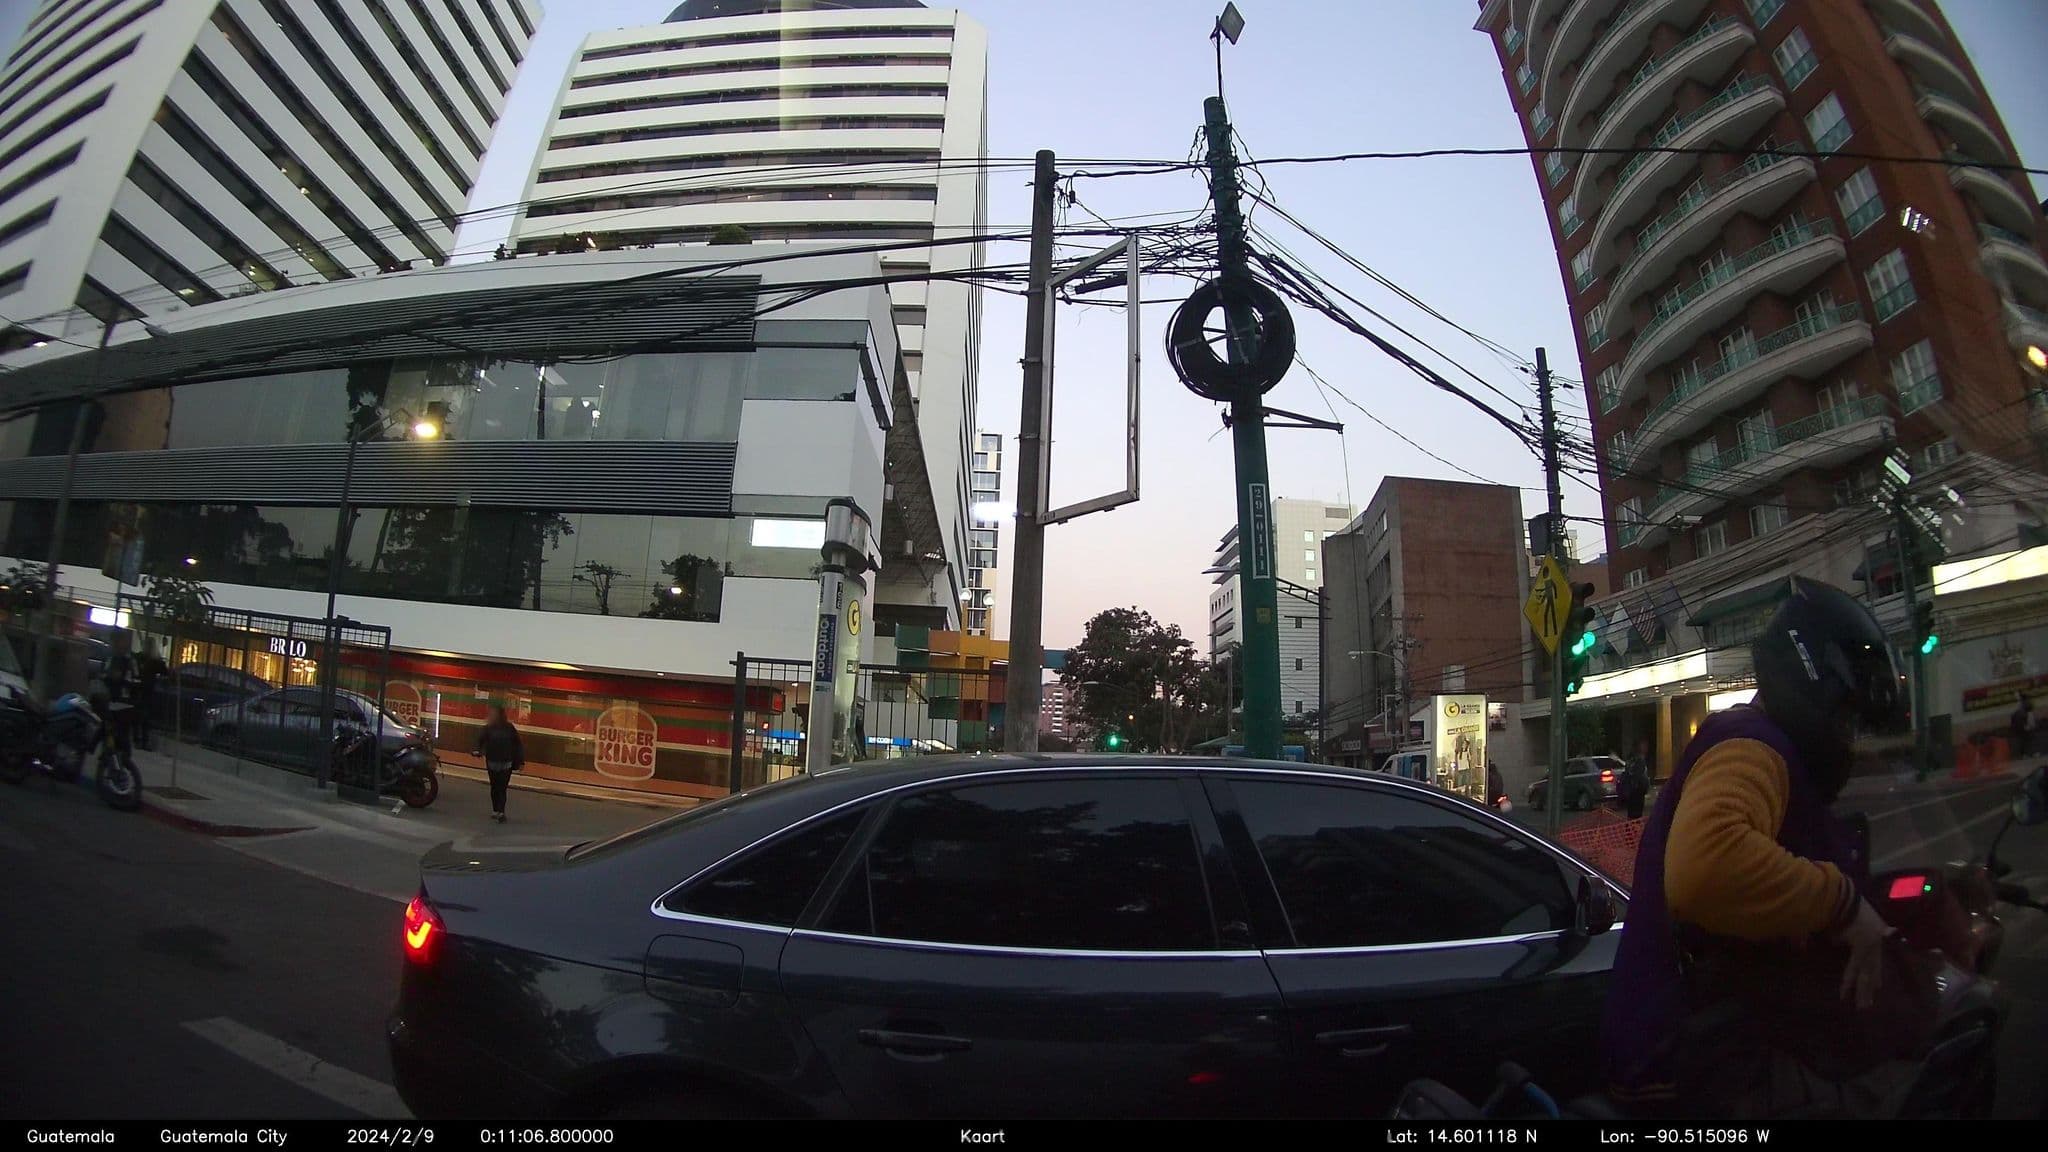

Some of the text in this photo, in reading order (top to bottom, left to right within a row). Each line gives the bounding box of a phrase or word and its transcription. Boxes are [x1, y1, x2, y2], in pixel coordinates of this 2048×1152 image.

[270, 637, 306, 657] BRLO
[816, 621, 830, 678] Outdoor
[599, 728, 654, 746] BURGER
[599, 742, 652, 766] KING
